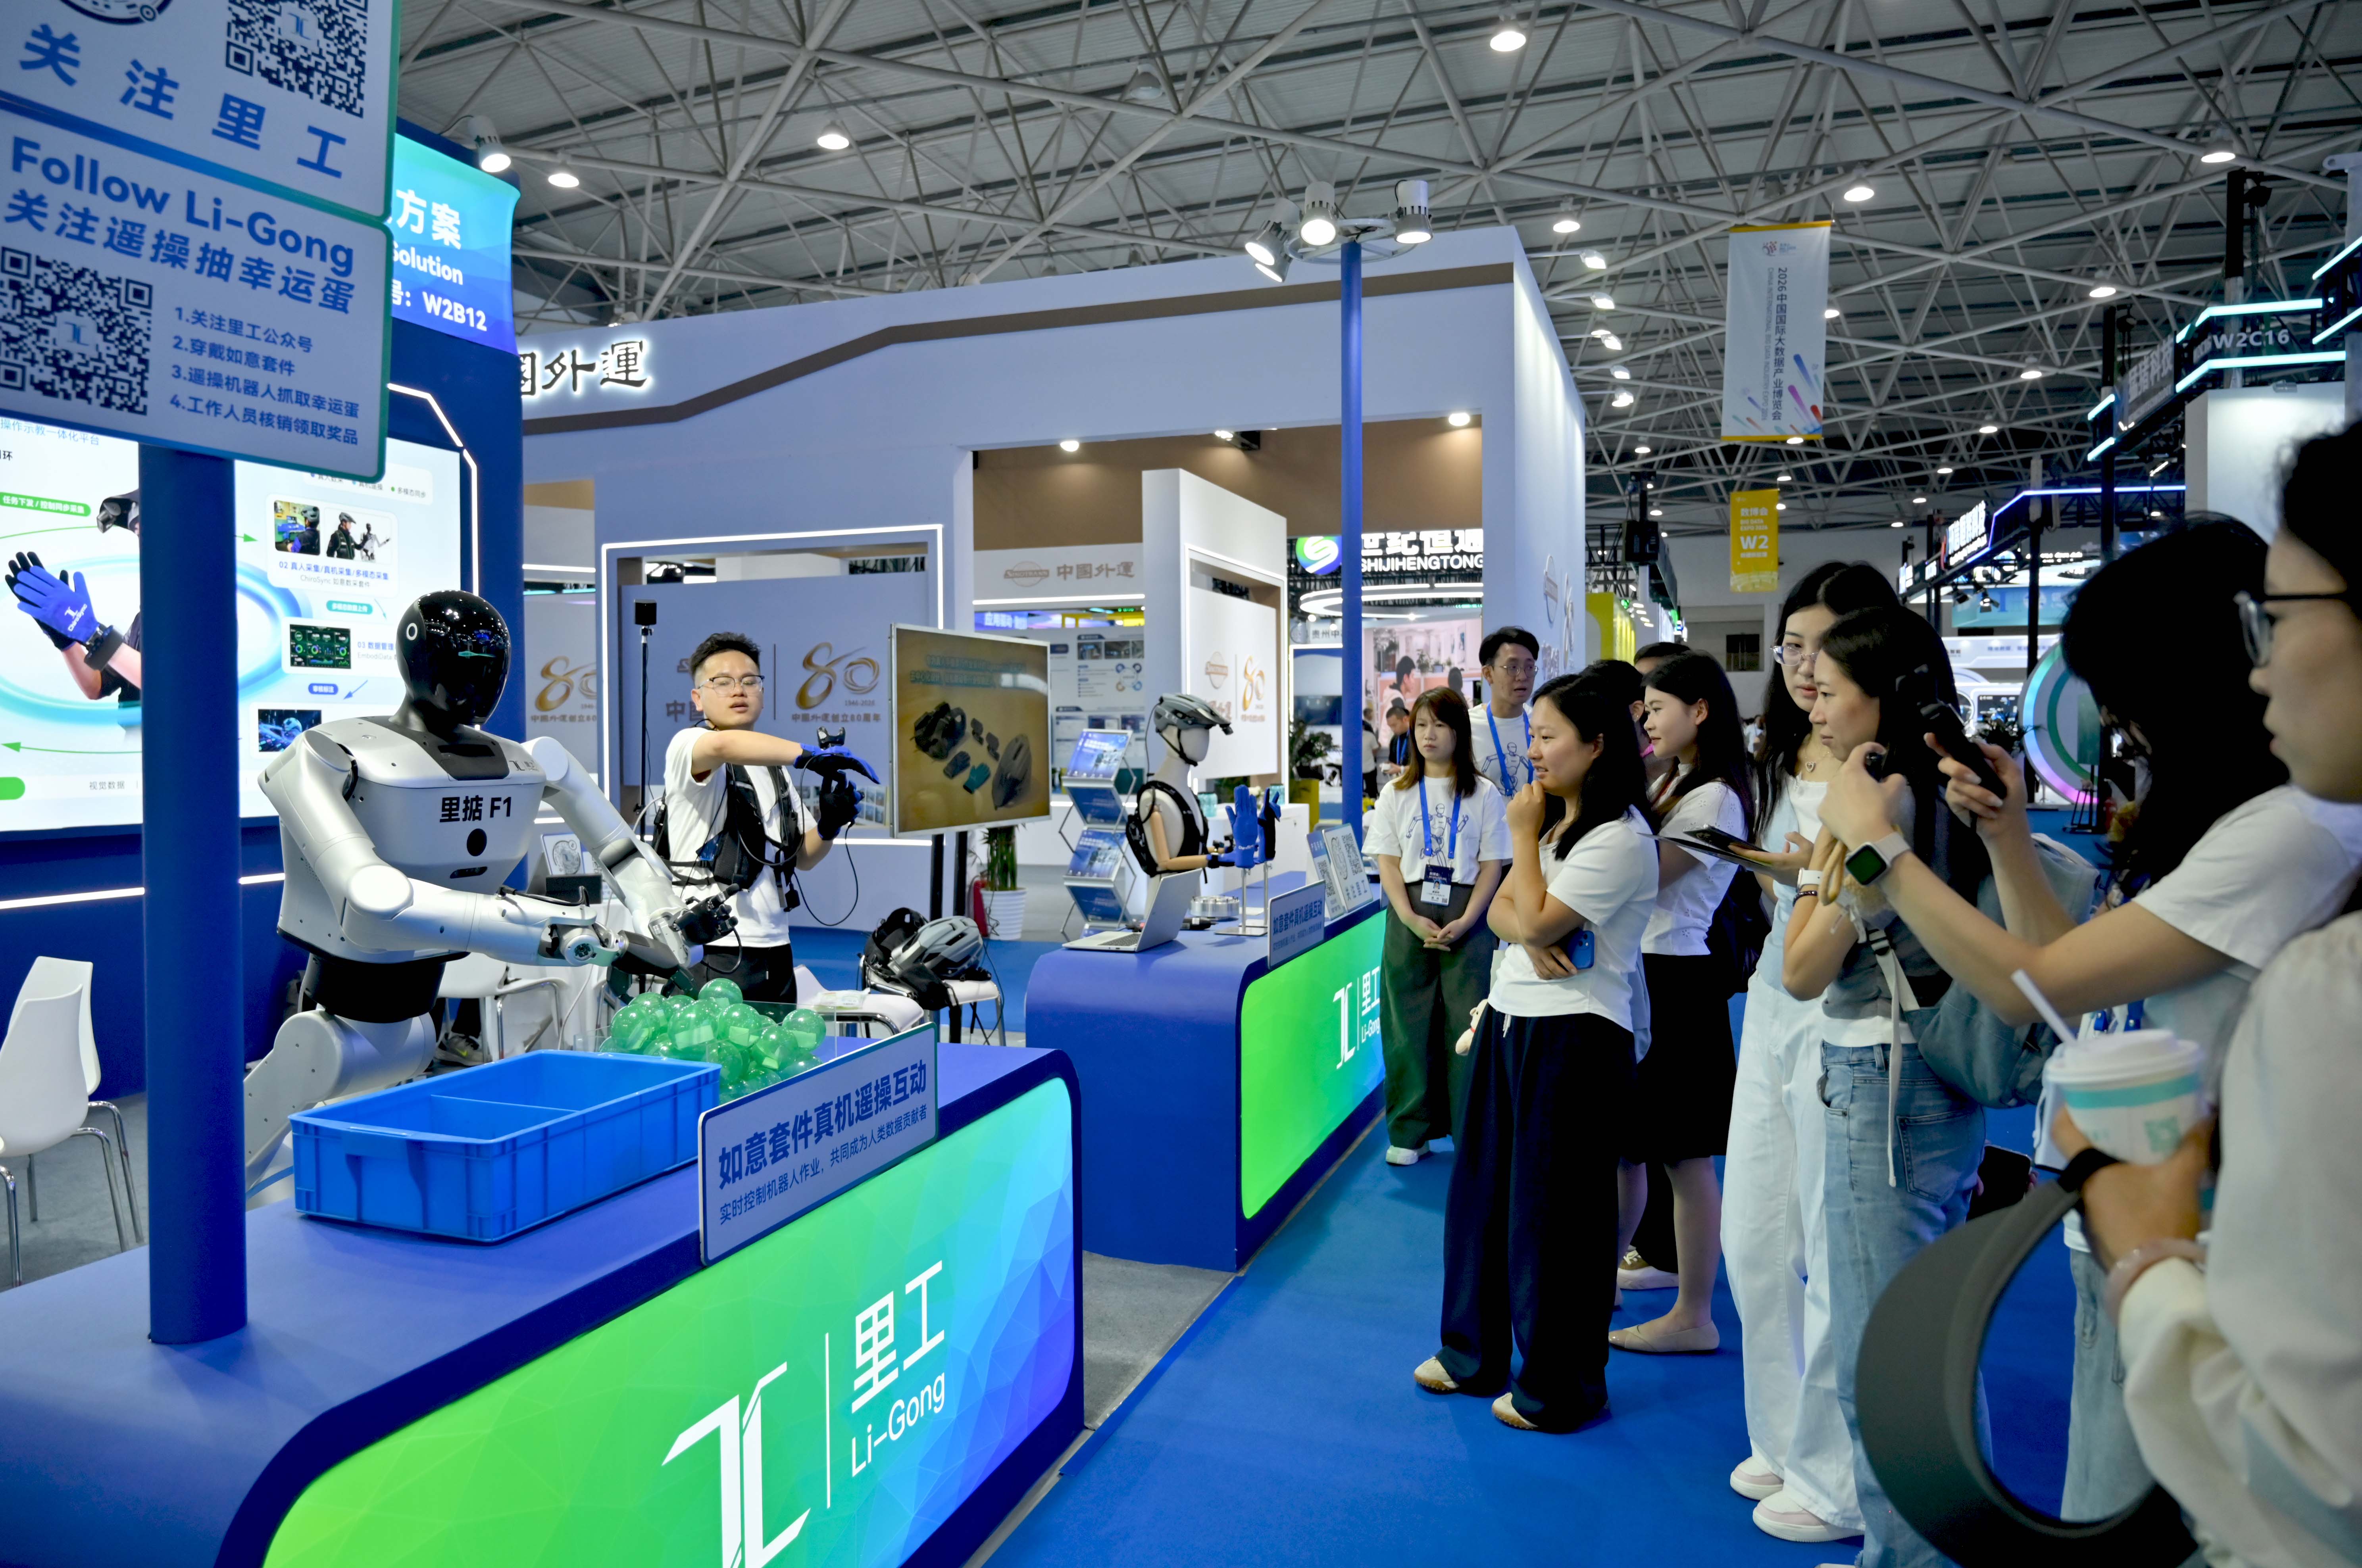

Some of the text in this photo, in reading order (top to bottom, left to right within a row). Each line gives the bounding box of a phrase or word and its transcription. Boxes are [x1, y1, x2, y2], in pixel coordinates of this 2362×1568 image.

[19, 24, 346, 179] 关注里工
[12, 137, 353, 276] Follow Li-Gong
[387, 189, 462, 250] 方案
[5, 189, 354, 314] 关注遥操抽幸运蛋
[175, 307, 313, 353] 1.关注里工公众号
[2213, 329, 2289, 349] W2C16
[173, 336, 295, 376] 2.穿戴如意套件
[172, 365, 359, 419] 3.遥操机器人抓取幸运蛋
[170, 394, 358, 445] 4.工作人员核销领取奖品
[0, 450, 13, 461] 环
[1362, 554, 1483, 572] SHIJIHENGTONG
[1740, 535, 1768, 550] W2
[1312, 630, 1342, 638] 贵州中
[89, 780, 125, 791] 视觉数据
[490, 797, 511, 818] F1
[1362, 966, 1379, 1016] 里工
[719, 1060, 927, 1189] 如意套件真机遥操互动
[720, 1104, 927, 1225] 实时控制机器人作业，共同成为人类数据贡献者
[852, 1261, 944, 1414] 里工
[852, 1373, 945, 1477] Li-Gong
